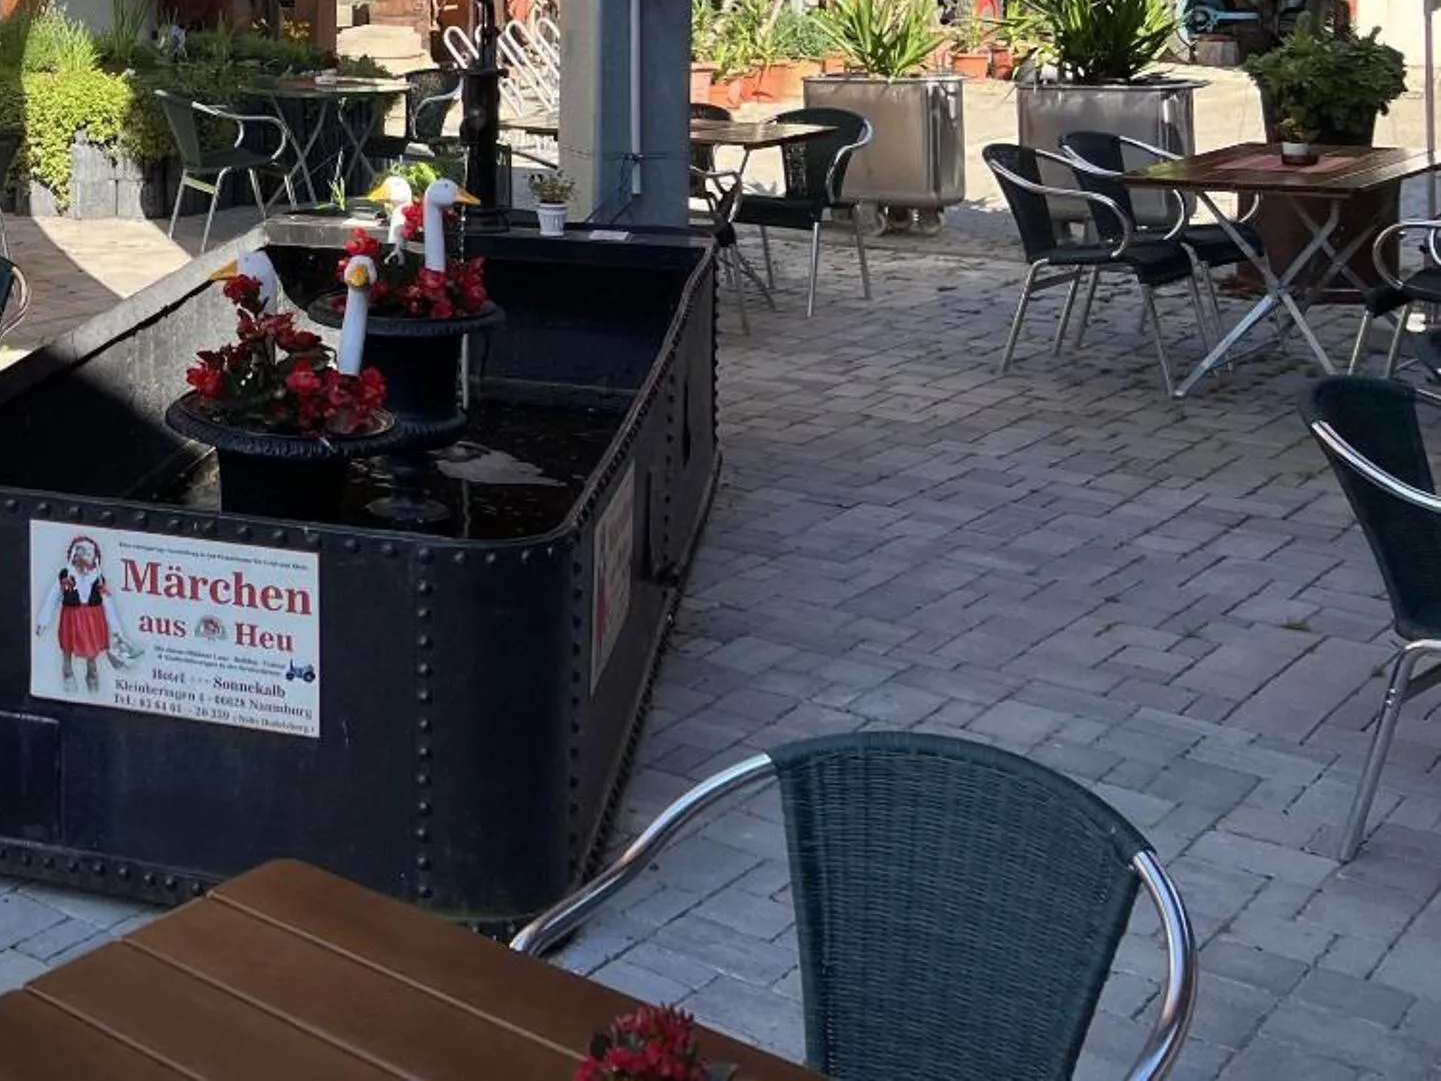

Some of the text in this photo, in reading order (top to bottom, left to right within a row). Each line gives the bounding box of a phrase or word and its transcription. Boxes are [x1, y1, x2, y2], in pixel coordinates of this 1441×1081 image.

[121, 558, 312, 615] Märchen
[139, 615, 294, 652] aus Heu
